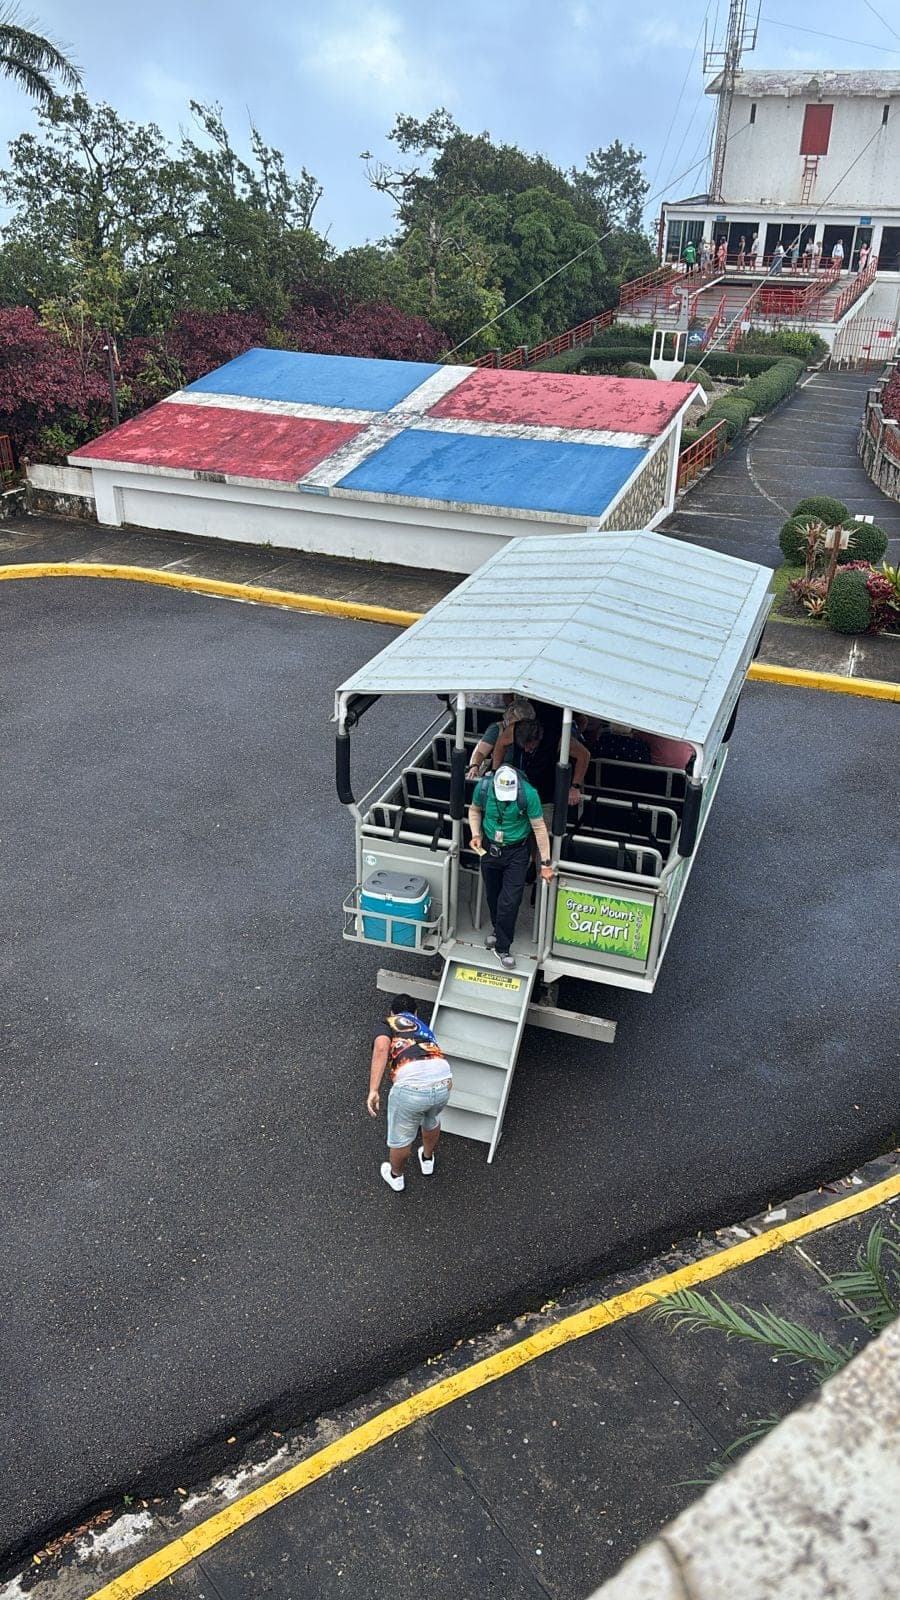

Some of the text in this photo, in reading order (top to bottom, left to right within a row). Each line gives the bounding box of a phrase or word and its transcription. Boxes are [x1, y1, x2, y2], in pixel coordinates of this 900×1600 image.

[566, 898, 635, 922] Green Mount
[568, 912, 629, 942] Safari
